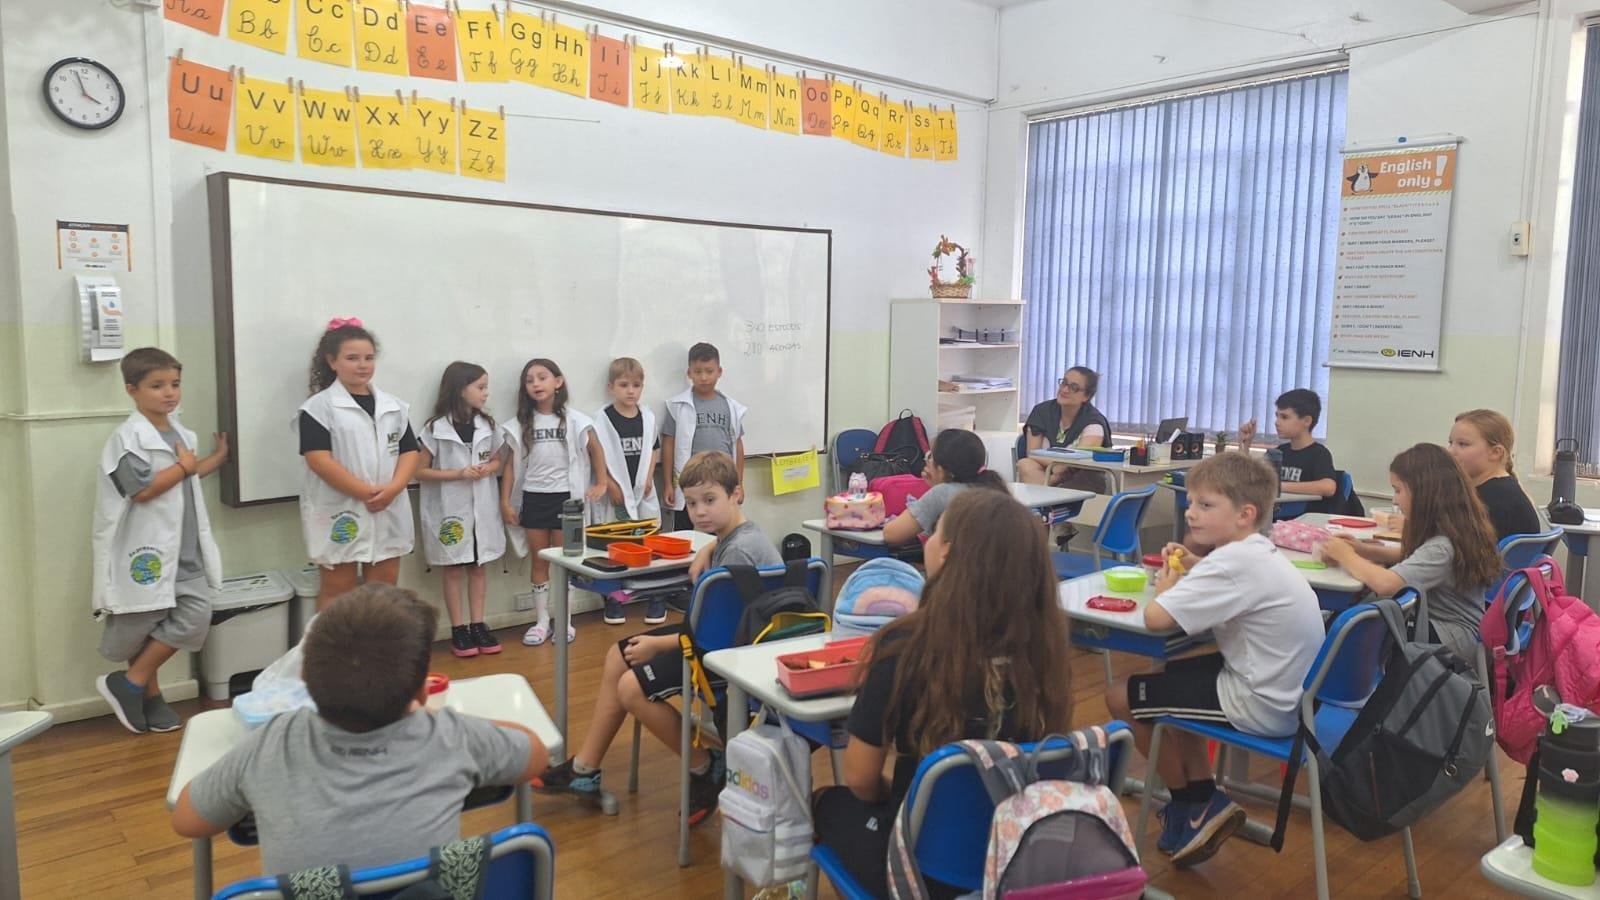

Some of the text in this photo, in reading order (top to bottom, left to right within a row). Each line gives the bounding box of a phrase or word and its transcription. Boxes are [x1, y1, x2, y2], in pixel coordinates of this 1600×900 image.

[1380, 158, 1432, 175] English
[1398, 349, 1434, 358] IENH
[697, 412, 727, 426] ENH
